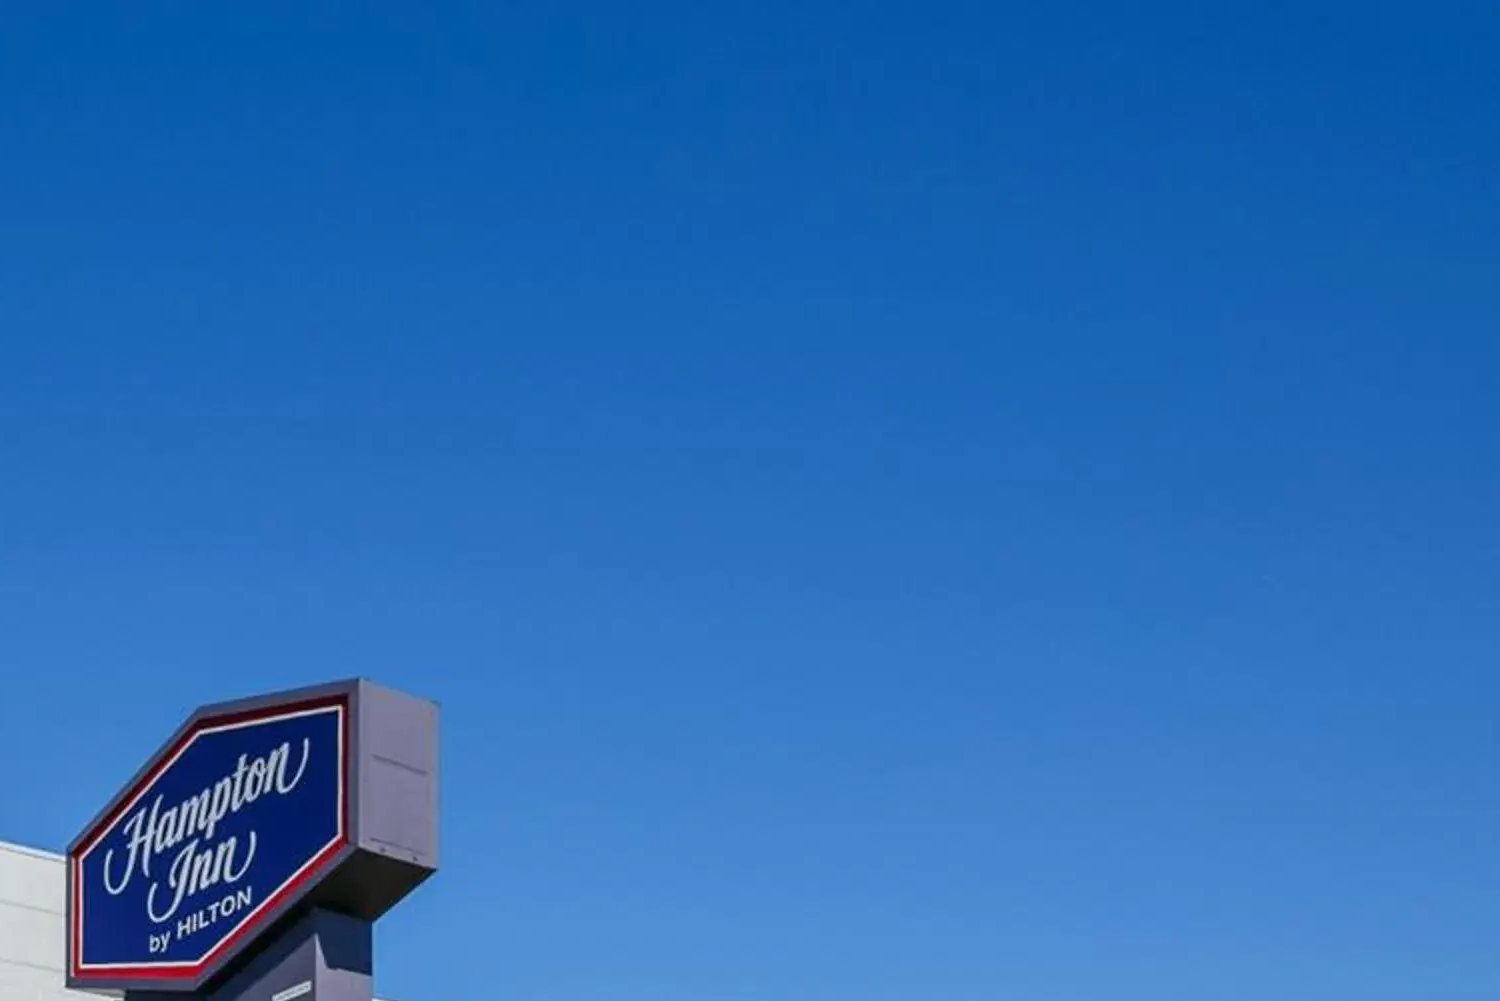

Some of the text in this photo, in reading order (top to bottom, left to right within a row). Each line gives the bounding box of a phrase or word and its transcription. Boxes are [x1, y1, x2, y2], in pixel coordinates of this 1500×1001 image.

[104, 738, 309, 895] Hampton
[147, 832, 257, 923] Inn
[149, 885, 252, 953] by HILTON
